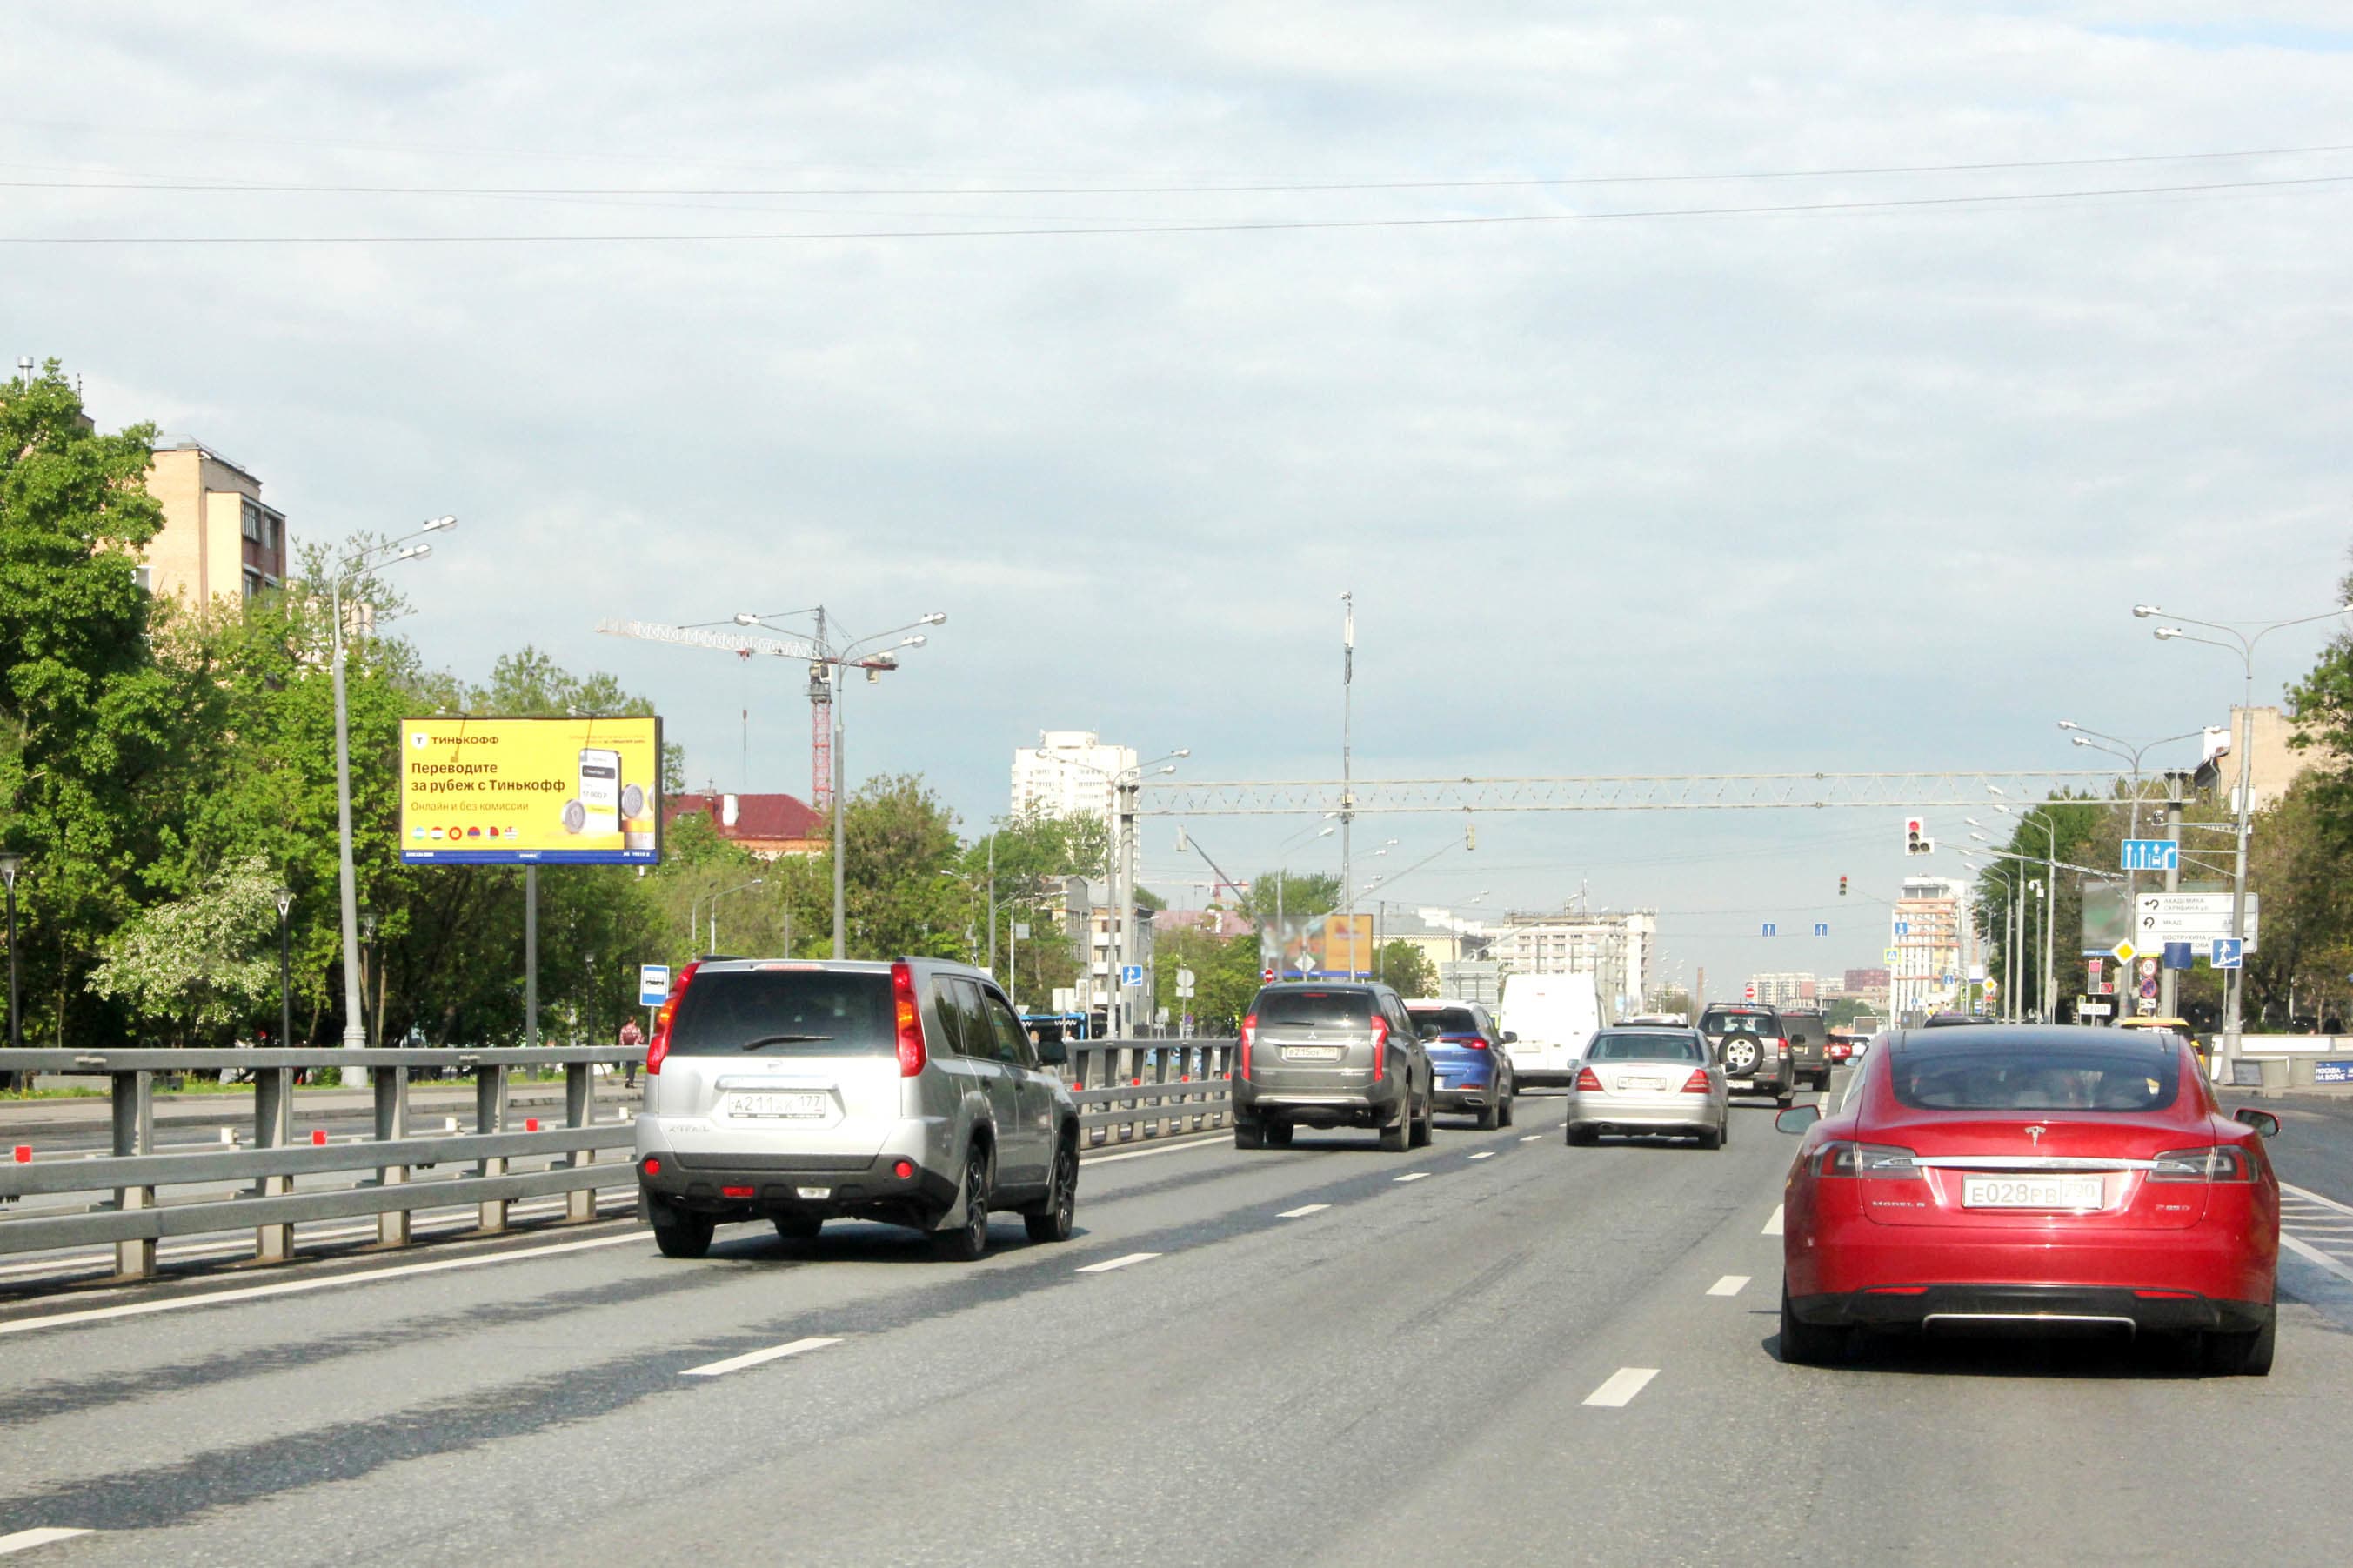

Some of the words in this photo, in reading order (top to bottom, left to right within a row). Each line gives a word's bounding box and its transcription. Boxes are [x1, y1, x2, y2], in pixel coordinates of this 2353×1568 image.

[411, 763, 498, 777] Переводите
[411, 781, 427, 791] за
[430, 778, 475, 794] рубеж
[478, 781, 487, 791] с
[489, 778, 565, 793] Тинькофф
[411, 801, 449, 811] Онлайн
[459, 800, 478, 811] без
[480, 803, 529, 811] комиссии
[2145, 963, 2154, 972] 50
[799, 1095, 821, 1107] 177
